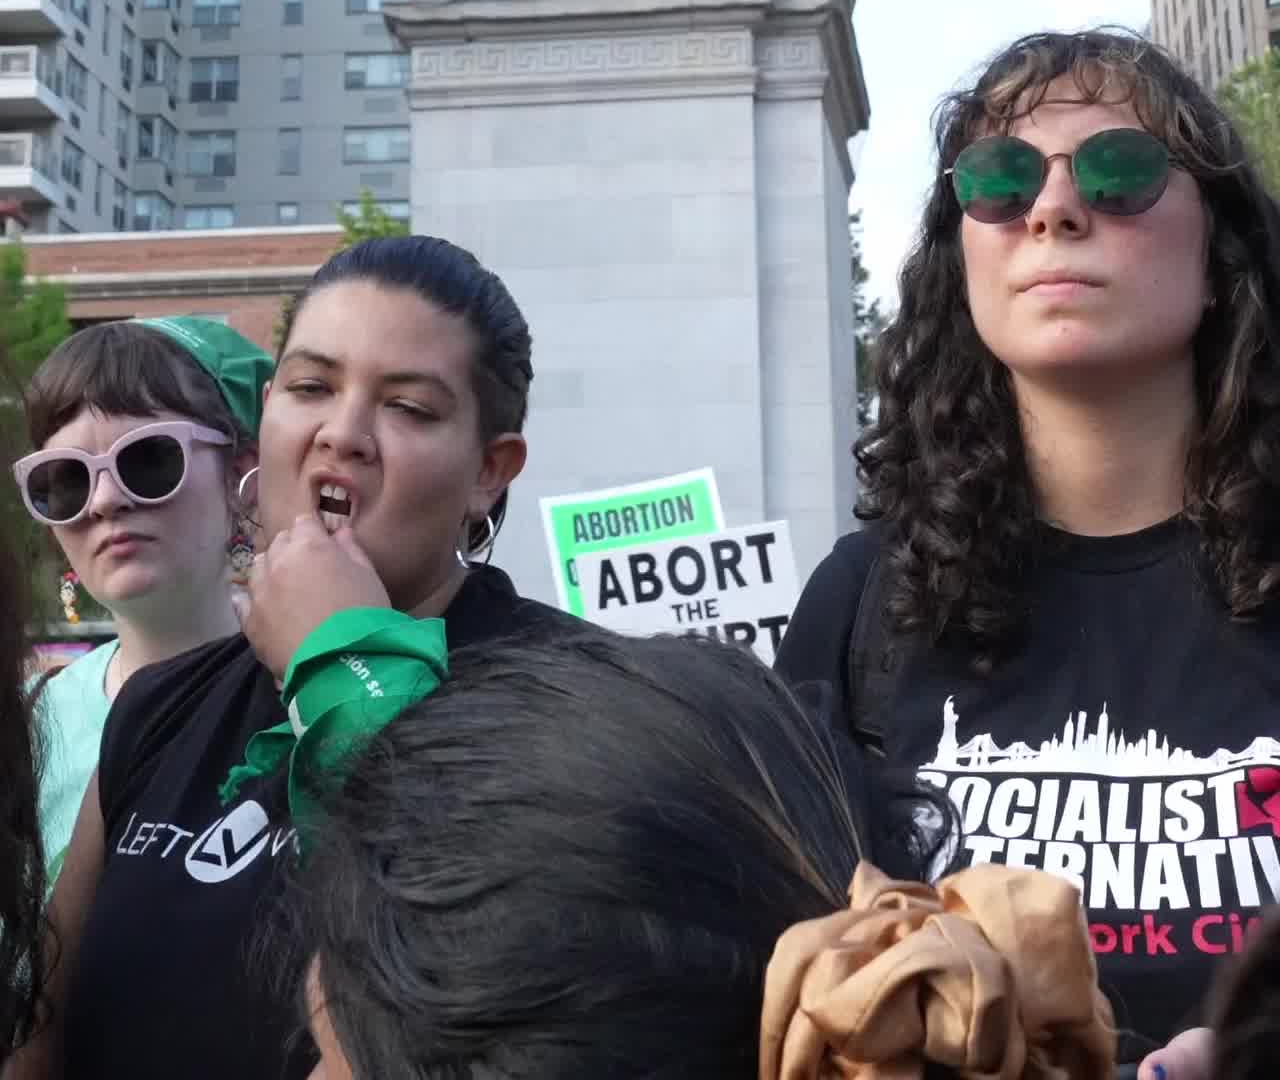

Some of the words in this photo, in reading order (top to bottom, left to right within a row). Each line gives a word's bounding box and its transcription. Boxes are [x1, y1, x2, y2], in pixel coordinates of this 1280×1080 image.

[572, 493, 695, 544] ABORTION
[598, 531, 776, 610] ABORT
[670, 598, 720, 625] THE
[116, 812, 194, 858] LEFT
[1086, 914, 1179, 956] ork
